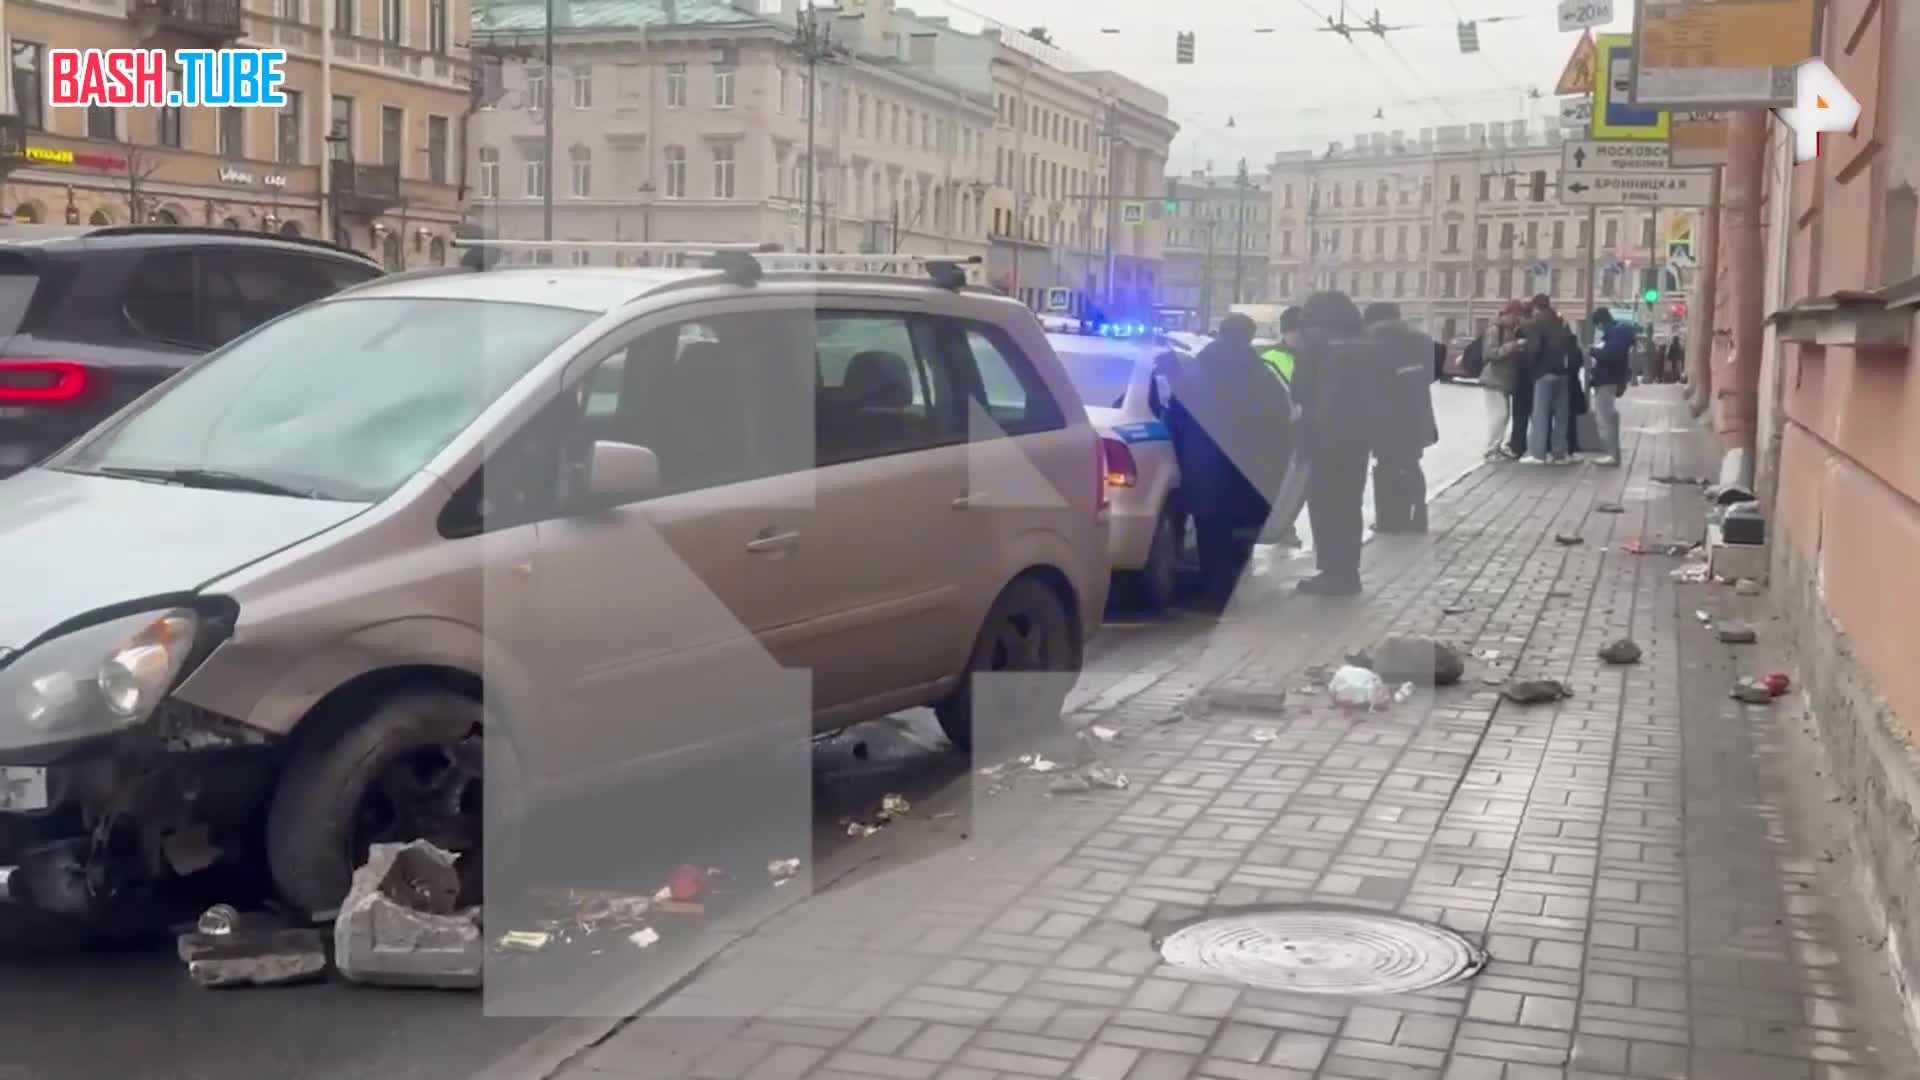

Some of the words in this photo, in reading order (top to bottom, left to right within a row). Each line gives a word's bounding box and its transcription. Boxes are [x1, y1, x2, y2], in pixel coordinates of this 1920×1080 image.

[1576, 4, 1595, 22] 20
[1596, 146, 1669, 157] МОСКОВСК
[1594, 178, 1687, 190] БРОННИЦКАЯ
